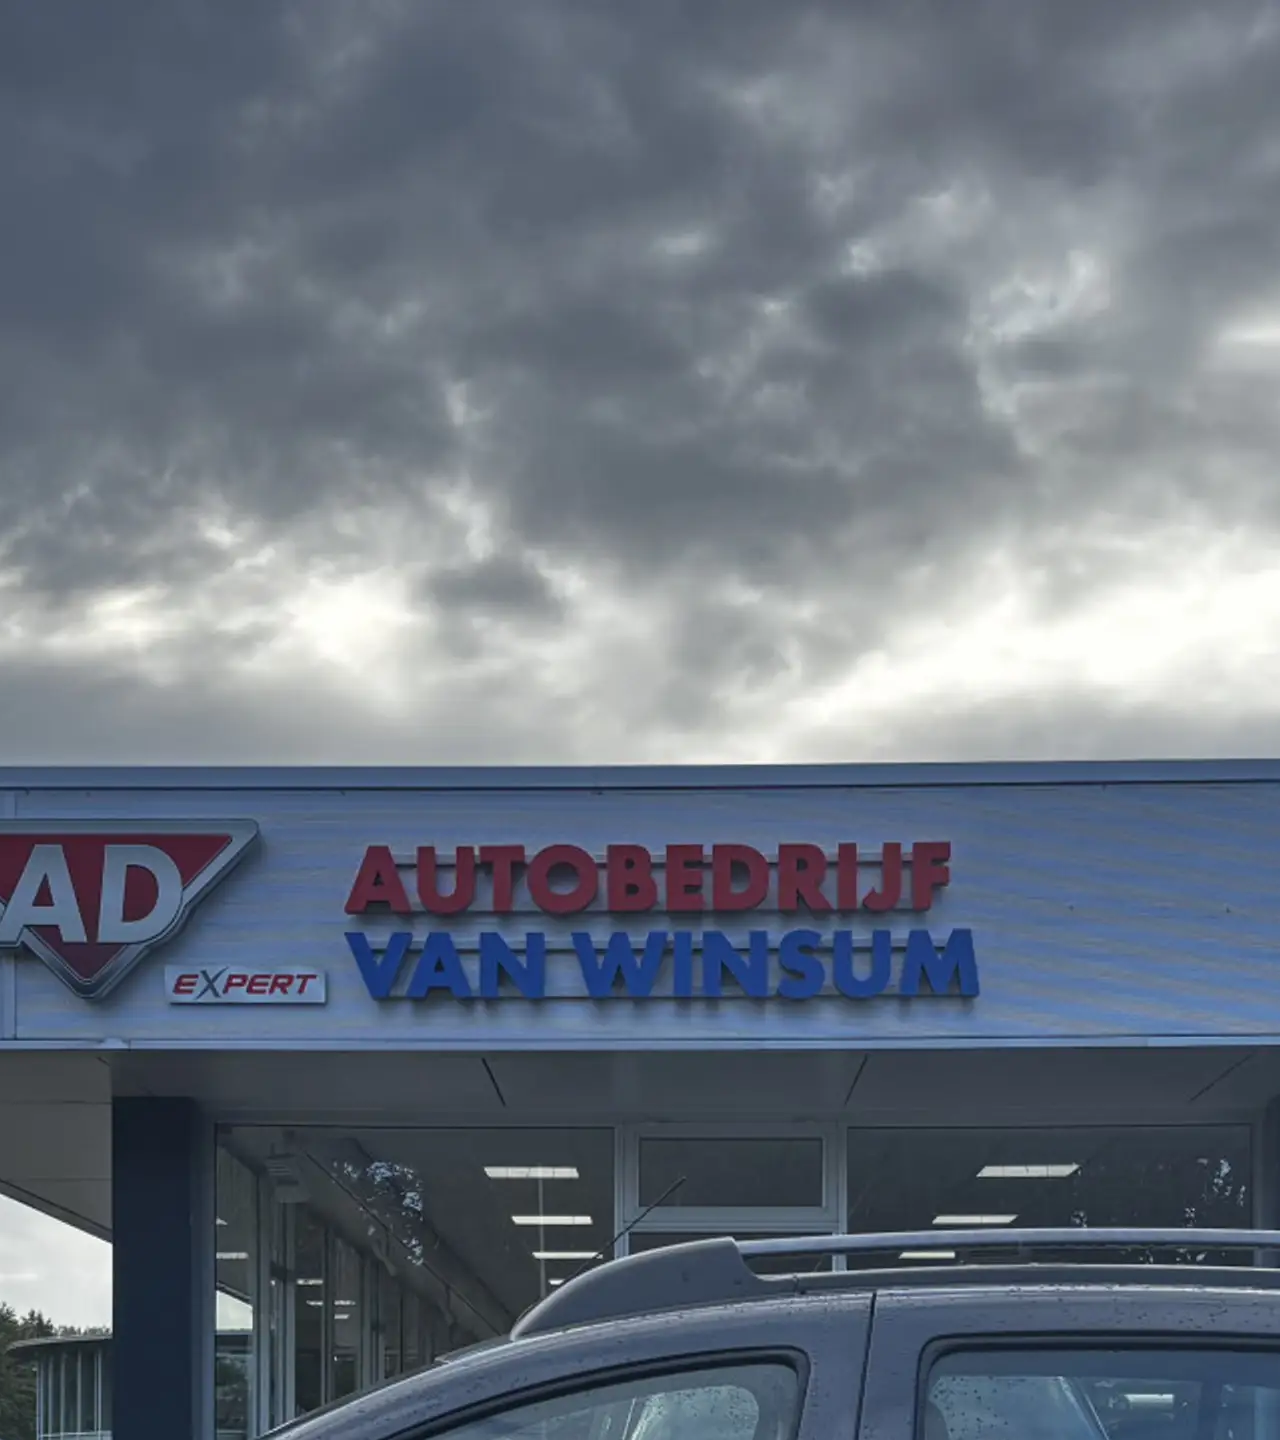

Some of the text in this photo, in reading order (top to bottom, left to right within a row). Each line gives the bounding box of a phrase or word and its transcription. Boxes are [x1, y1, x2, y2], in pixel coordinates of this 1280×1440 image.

[344, 841, 951, 914] AUTOBEDRIJF
[344, 929, 979, 999] VAN WINSUM
